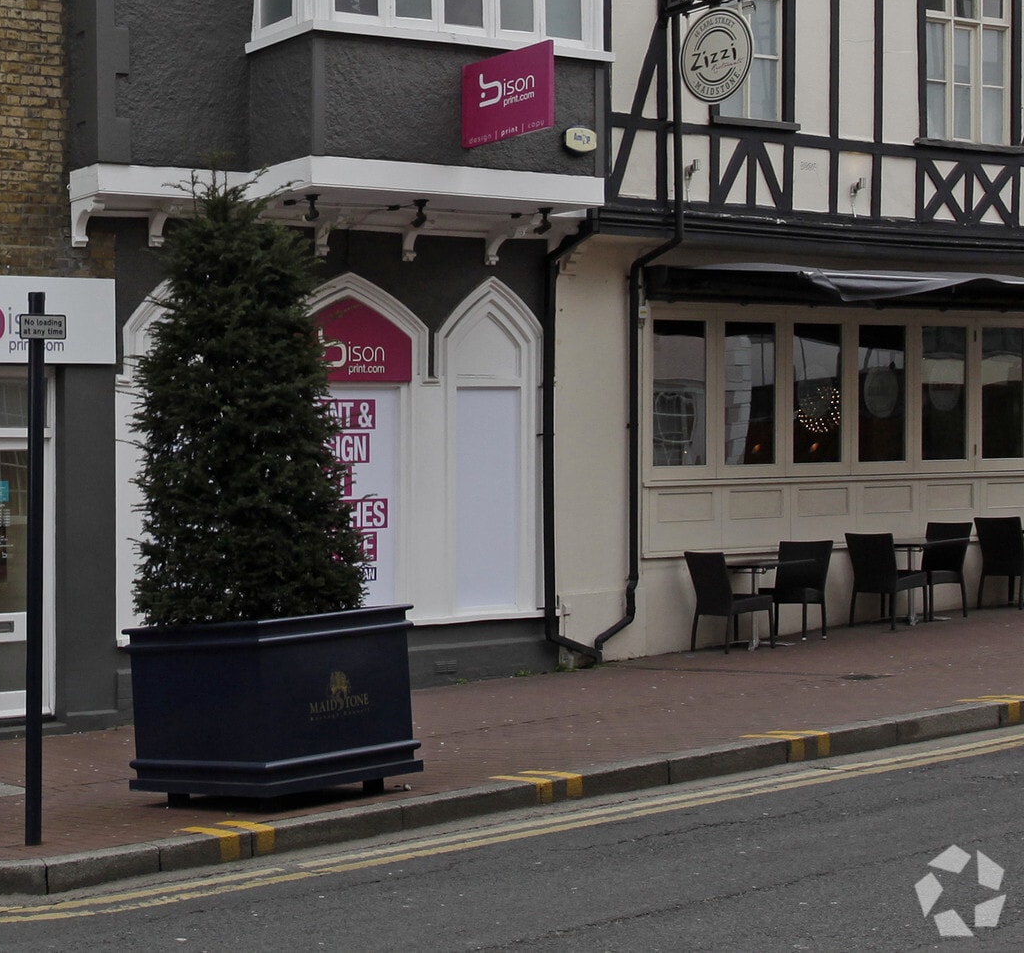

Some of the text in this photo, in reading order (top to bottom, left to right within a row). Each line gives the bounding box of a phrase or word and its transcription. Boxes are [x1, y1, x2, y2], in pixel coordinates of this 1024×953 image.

[715, 16, 735, 28] STREET
[690, 42, 737, 71] Zizzi
[479, 73, 535, 107] bison
[695, 72, 740, 96] MAIDSTONE
[503, 91, 535, 107] print.com
[469, 120, 545, 145] design print copy
[24, 318, 63, 327] No loading
[32, 328, 45, 336] any
[348, 364, 385, 375] print.com
[309, 693, 369, 714] MAIDSTONE
